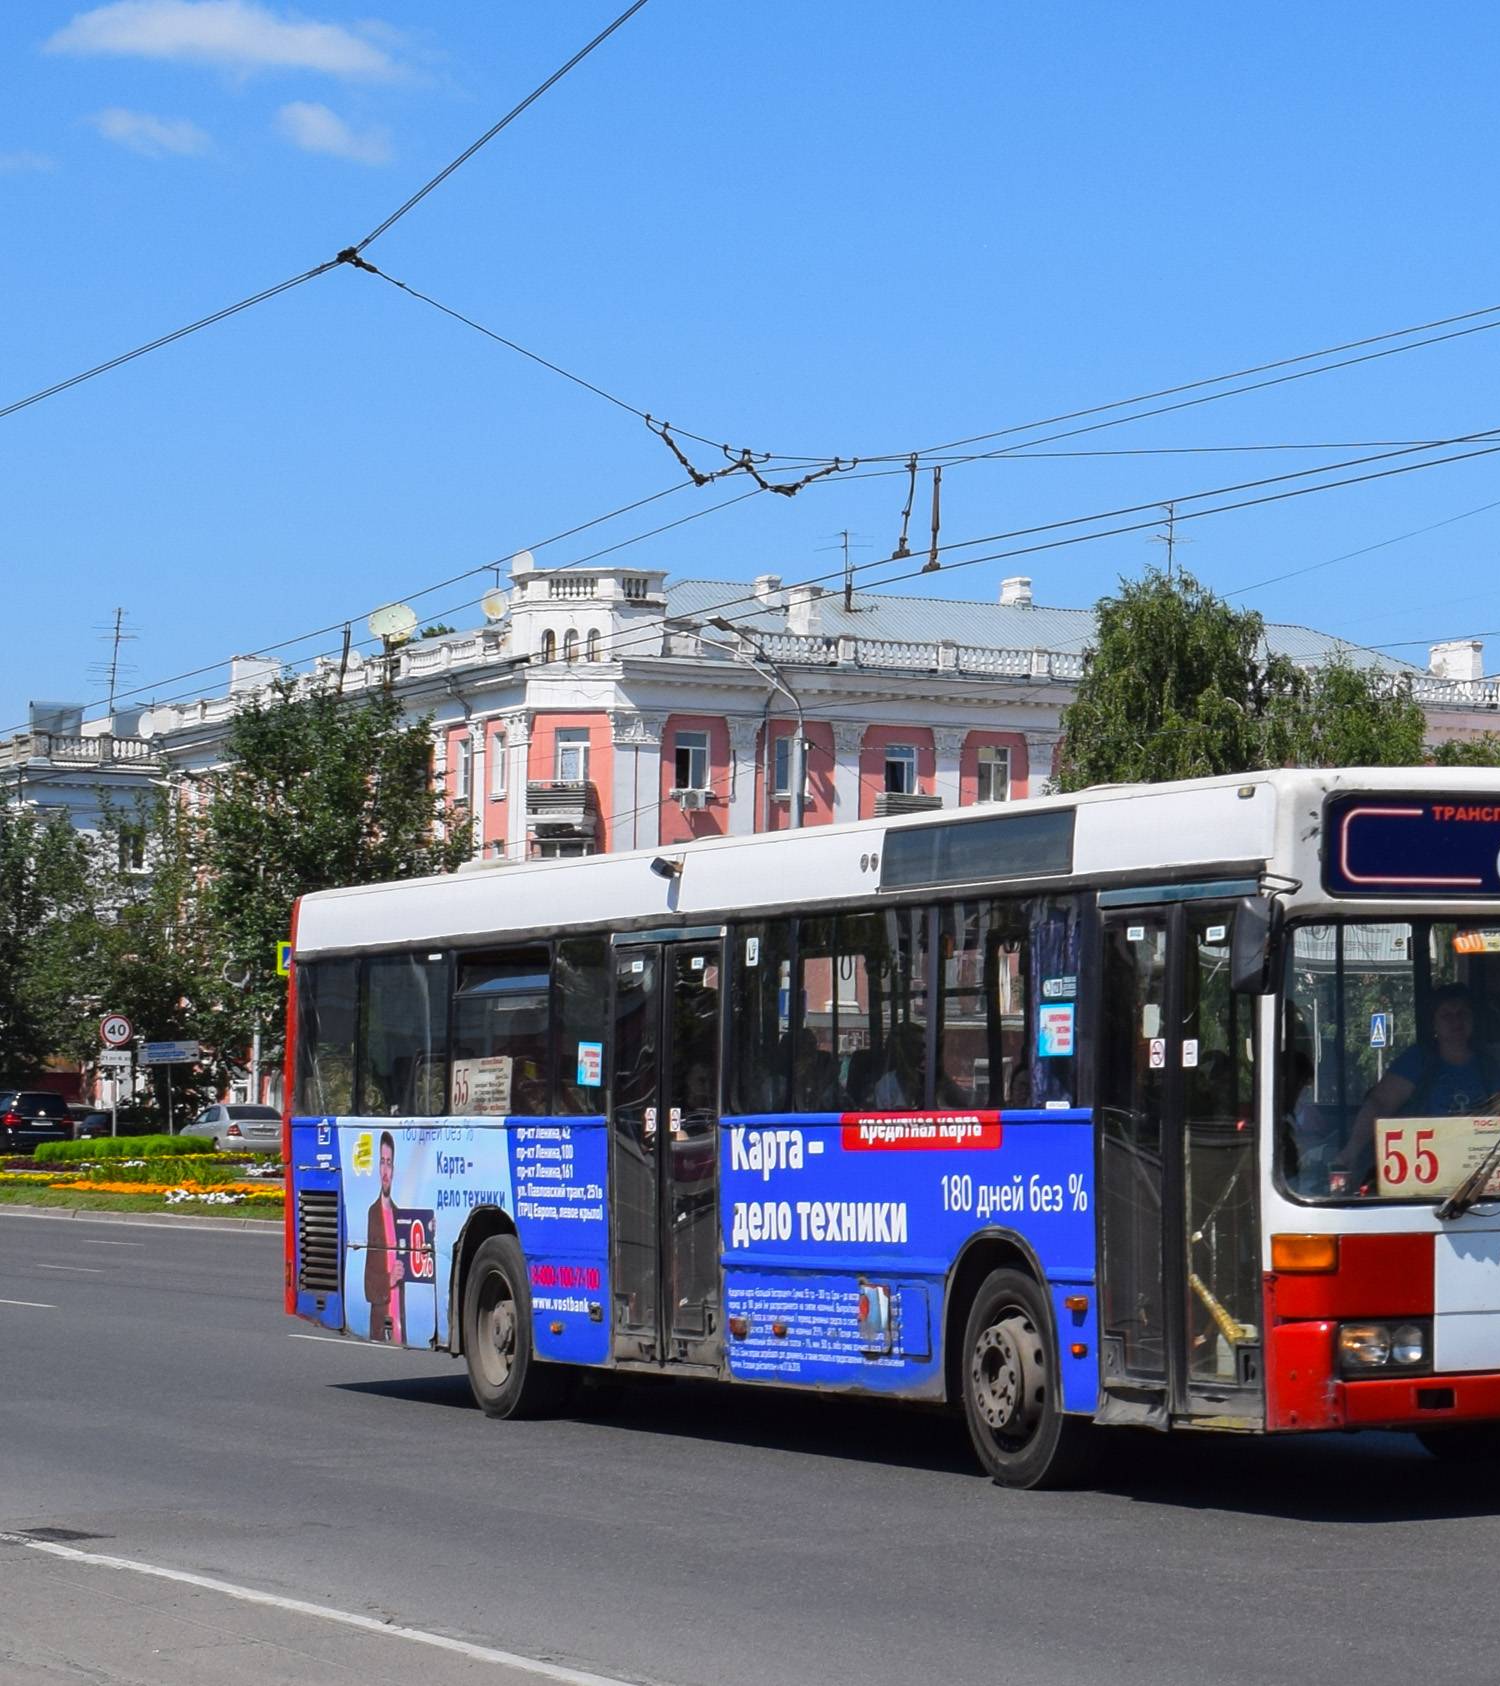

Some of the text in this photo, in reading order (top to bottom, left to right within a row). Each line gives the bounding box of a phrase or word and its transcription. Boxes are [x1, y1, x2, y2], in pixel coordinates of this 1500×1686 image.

[107, 1025, 126, 1037] 40
[454, 1068, 470, 1107] 55
[436, 1151, 466, 1179] Карта
[731, 1124, 804, 1182] Карта
[1383, 1129, 1439, 1185] 55
[437, 1190, 506, 1211] дело техники
[941, 1173, 1089, 1218] 180 дней без %
[732, 1200, 908, 1248] дело техники
